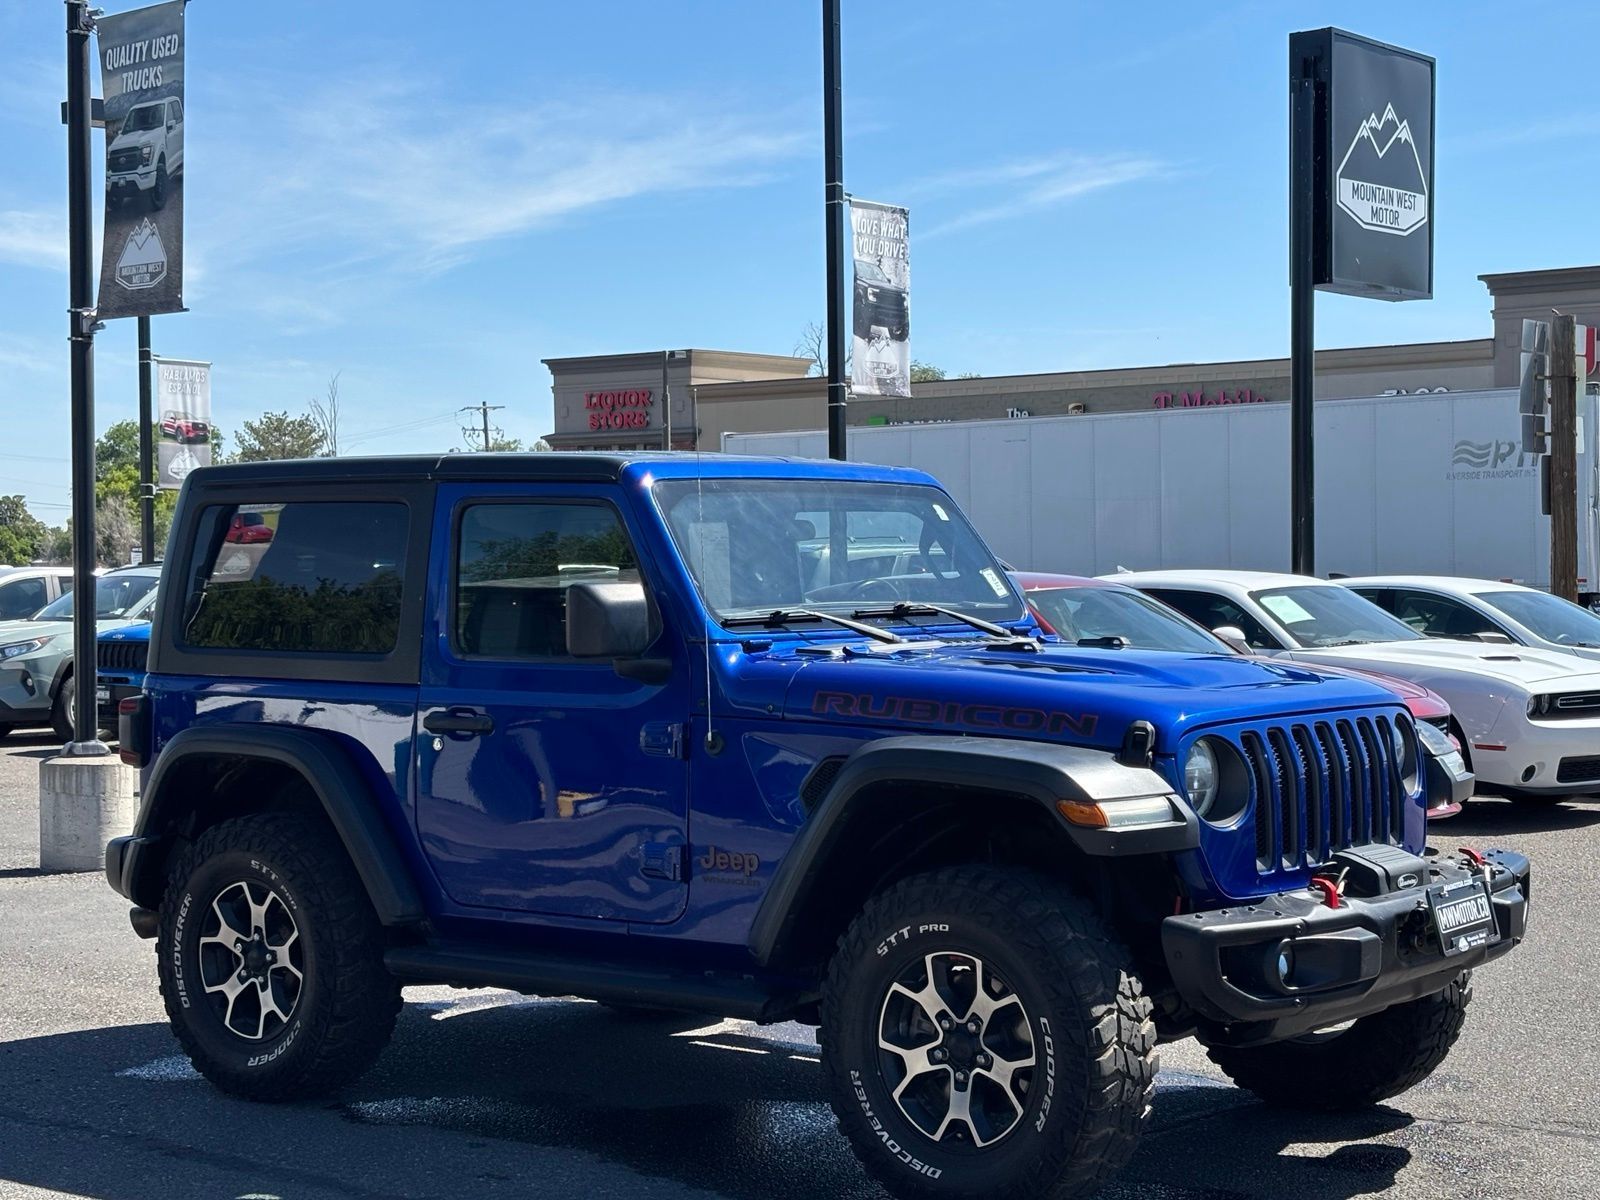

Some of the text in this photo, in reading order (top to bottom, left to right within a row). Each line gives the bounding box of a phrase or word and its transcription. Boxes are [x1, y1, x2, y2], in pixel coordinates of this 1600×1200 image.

[106, 34, 179, 71] QUALITY USED
[122, 65, 163, 93] TRUCKS
[1351, 182, 1417, 211] MOUNTAIN WEST
[857, 217, 906, 239] LOVE WHAT
[1370, 205, 1400, 226] MOTOR
[858, 236, 905, 259] YOU DRIVE
[163, 368, 206, 383] HABLAMOS
[584, 388, 652, 410] LIQUOR
[588, 410, 649, 430] STORE
[1446, 471, 1481, 480] RIVERSIDE
[1482, 469, 1522, 479] TRANSPORT
[812, 690, 1099, 737] RUBICON
[251, 859, 279, 880] STT
[700, 845, 760, 877] Jeep
[173, 893, 193, 1009] DISCOVERER
[876, 923, 950, 956] STT PRO
[248, 1019, 301, 1067] COOPER
[1035, 1016, 1055, 1133] COOPER
[850, 1069, 943, 1180] DISCOVERER
